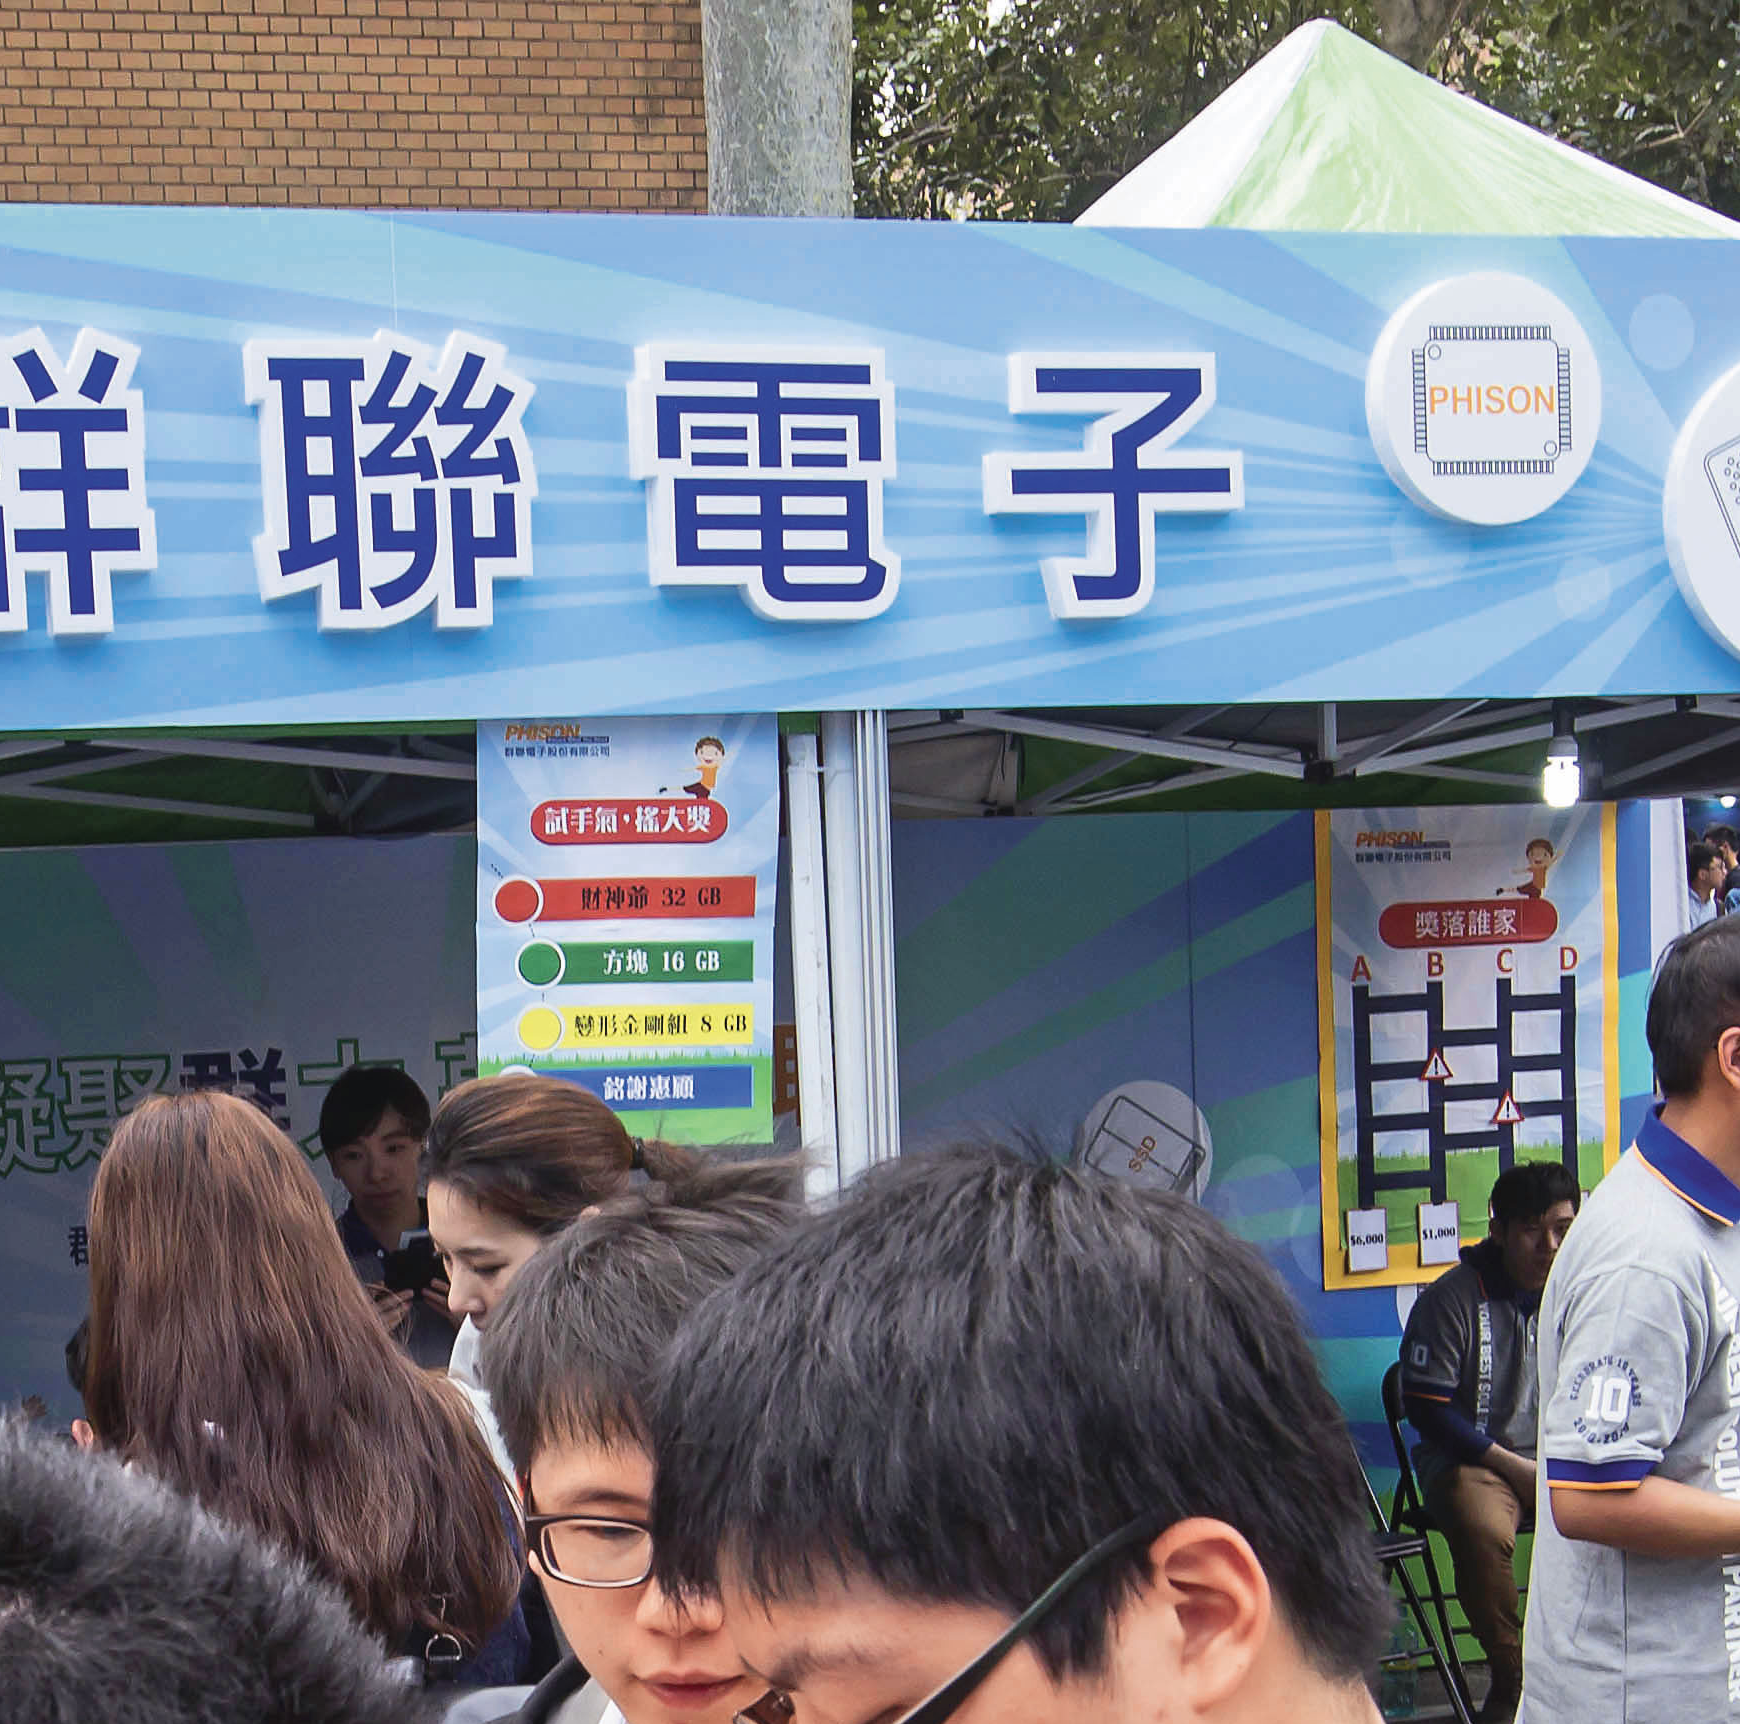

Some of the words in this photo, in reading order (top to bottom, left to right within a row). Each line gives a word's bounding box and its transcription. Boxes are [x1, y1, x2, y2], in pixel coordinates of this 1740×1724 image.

[1429, 385, 1555, 416] PHISON
[504, 723, 581, 742] PHISON
[1355, 830, 1423, 848] PHISON
[661, 887, 686, 907] 32
[698, 887, 722, 906] GB
[1413, 906, 1519, 940] 獎落誰家
[661, 950, 685, 973] 16
[694, 949, 720, 971] GB
[1351, 955, 1371, 983] A
[1426, 951, 1445, 978] B
[1495, 948, 1513, 973] C
[1559, 946, 1579, 971] D
[700, 1014, 712, 1033] 8
[723, 1014, 748, 1033] GB
[1128, 1135, 1157, 1173] SSD
[1584, 1375, 1631, 1423] 10
